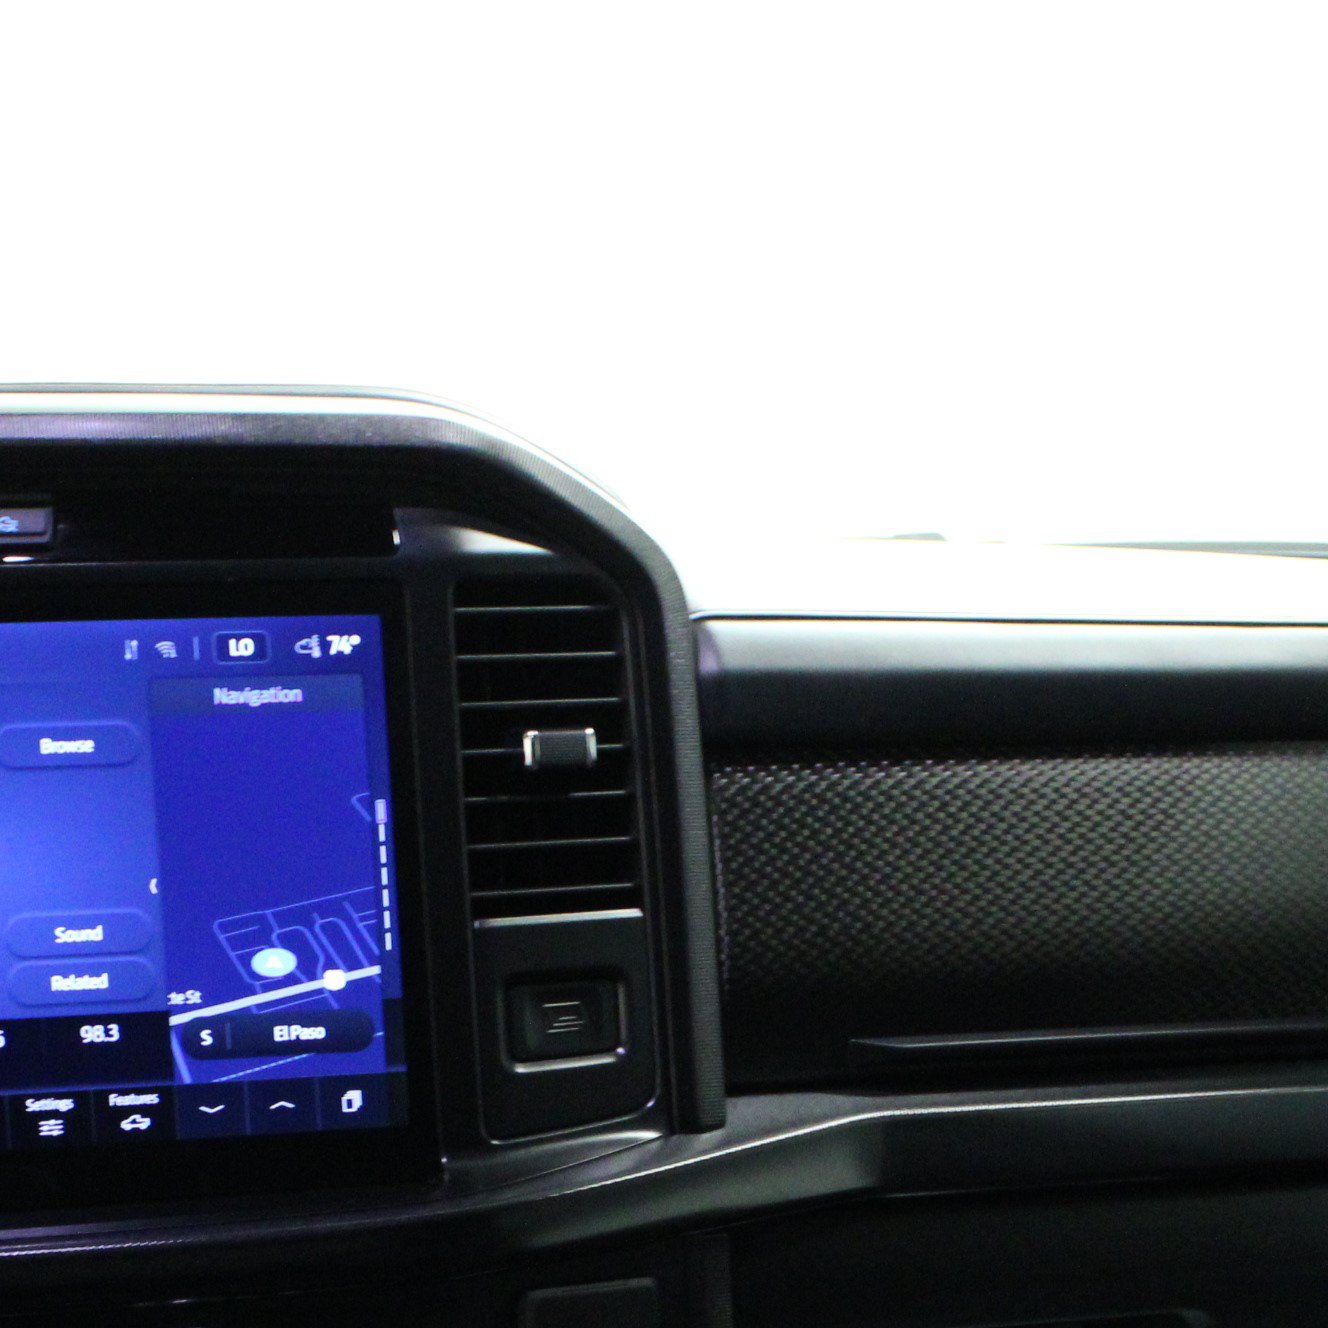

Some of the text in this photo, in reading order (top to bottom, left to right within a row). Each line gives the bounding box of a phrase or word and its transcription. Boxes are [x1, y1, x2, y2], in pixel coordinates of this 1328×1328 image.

[228, 637, 255, 657] LO
[212, 685, 304, 708] Navigation
[39, 737, 96, 755] Browse
[53, 924, 104, 944] Sound
[50, 972, 109, 992] Related
[79, 1023, 120, 1044] 98.3
[199, 1029, 214, 1047] S
[273, 1024, 326, 1042] El Paso
[24, 1096, 75, 1113] Settings
[108, 1092, 160, 1107] Features
